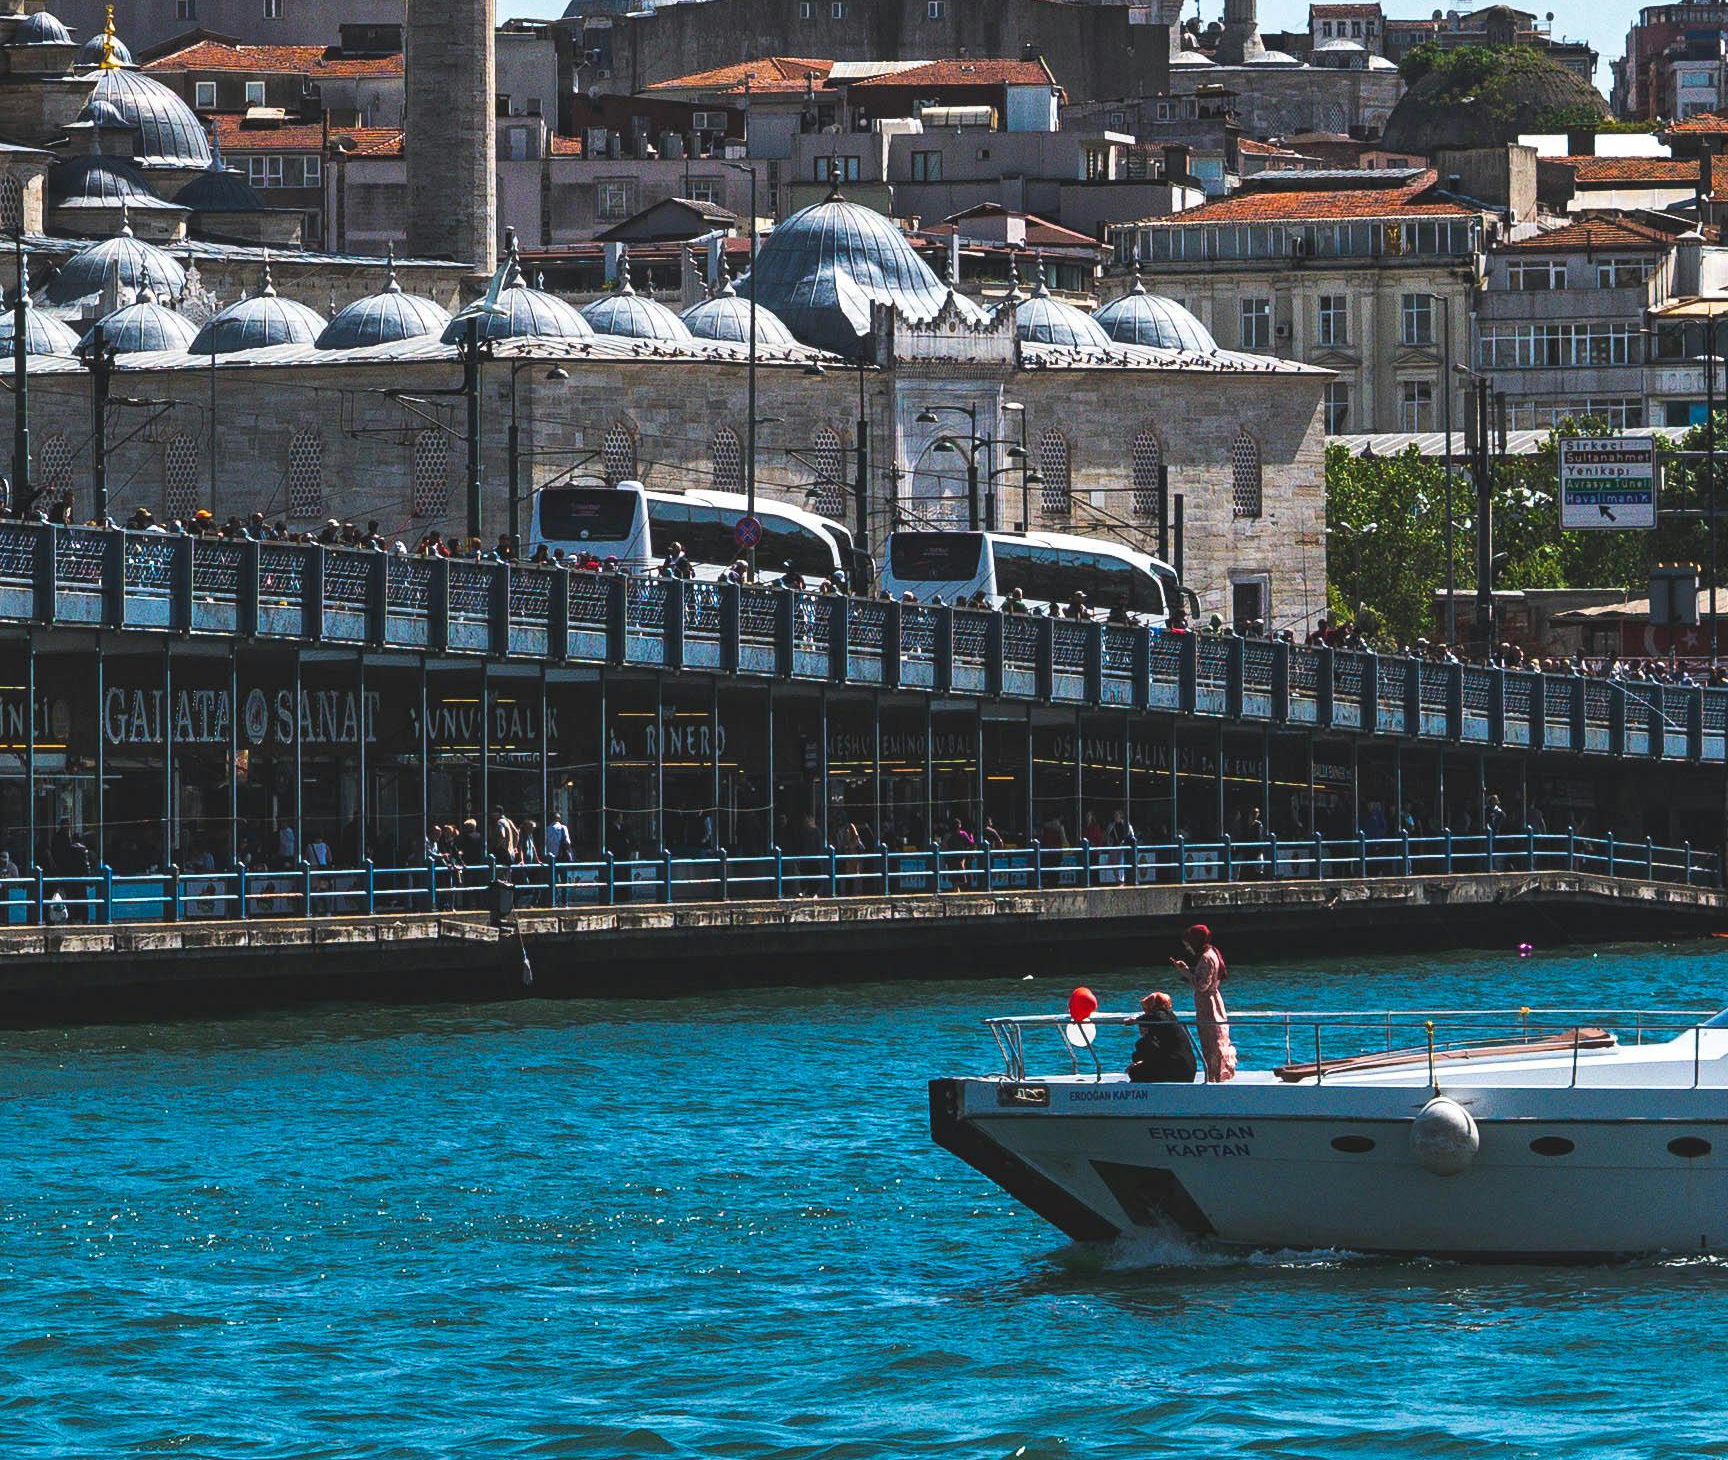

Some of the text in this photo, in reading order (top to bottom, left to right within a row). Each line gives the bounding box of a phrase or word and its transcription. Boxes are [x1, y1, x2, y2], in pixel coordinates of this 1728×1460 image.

[1566, 441, 1624, 450] Sirkeci
[1566, 452, 1649, 462] Sultanahmet
[1567, 466, 1630, 477] Yenikapı
[1566, 479, 1611, 490] Avrasya
[274, 688, 381, 744] SANAT
[495, 707, 559, 739] BALK
[1069, 1089, 1149, 1102] ERDOĞAN KAPTAN
[1148, 1123, 1255, 1141] ERDOĞAN
[1165, 1143, 1251, 1158] KAPTAN
